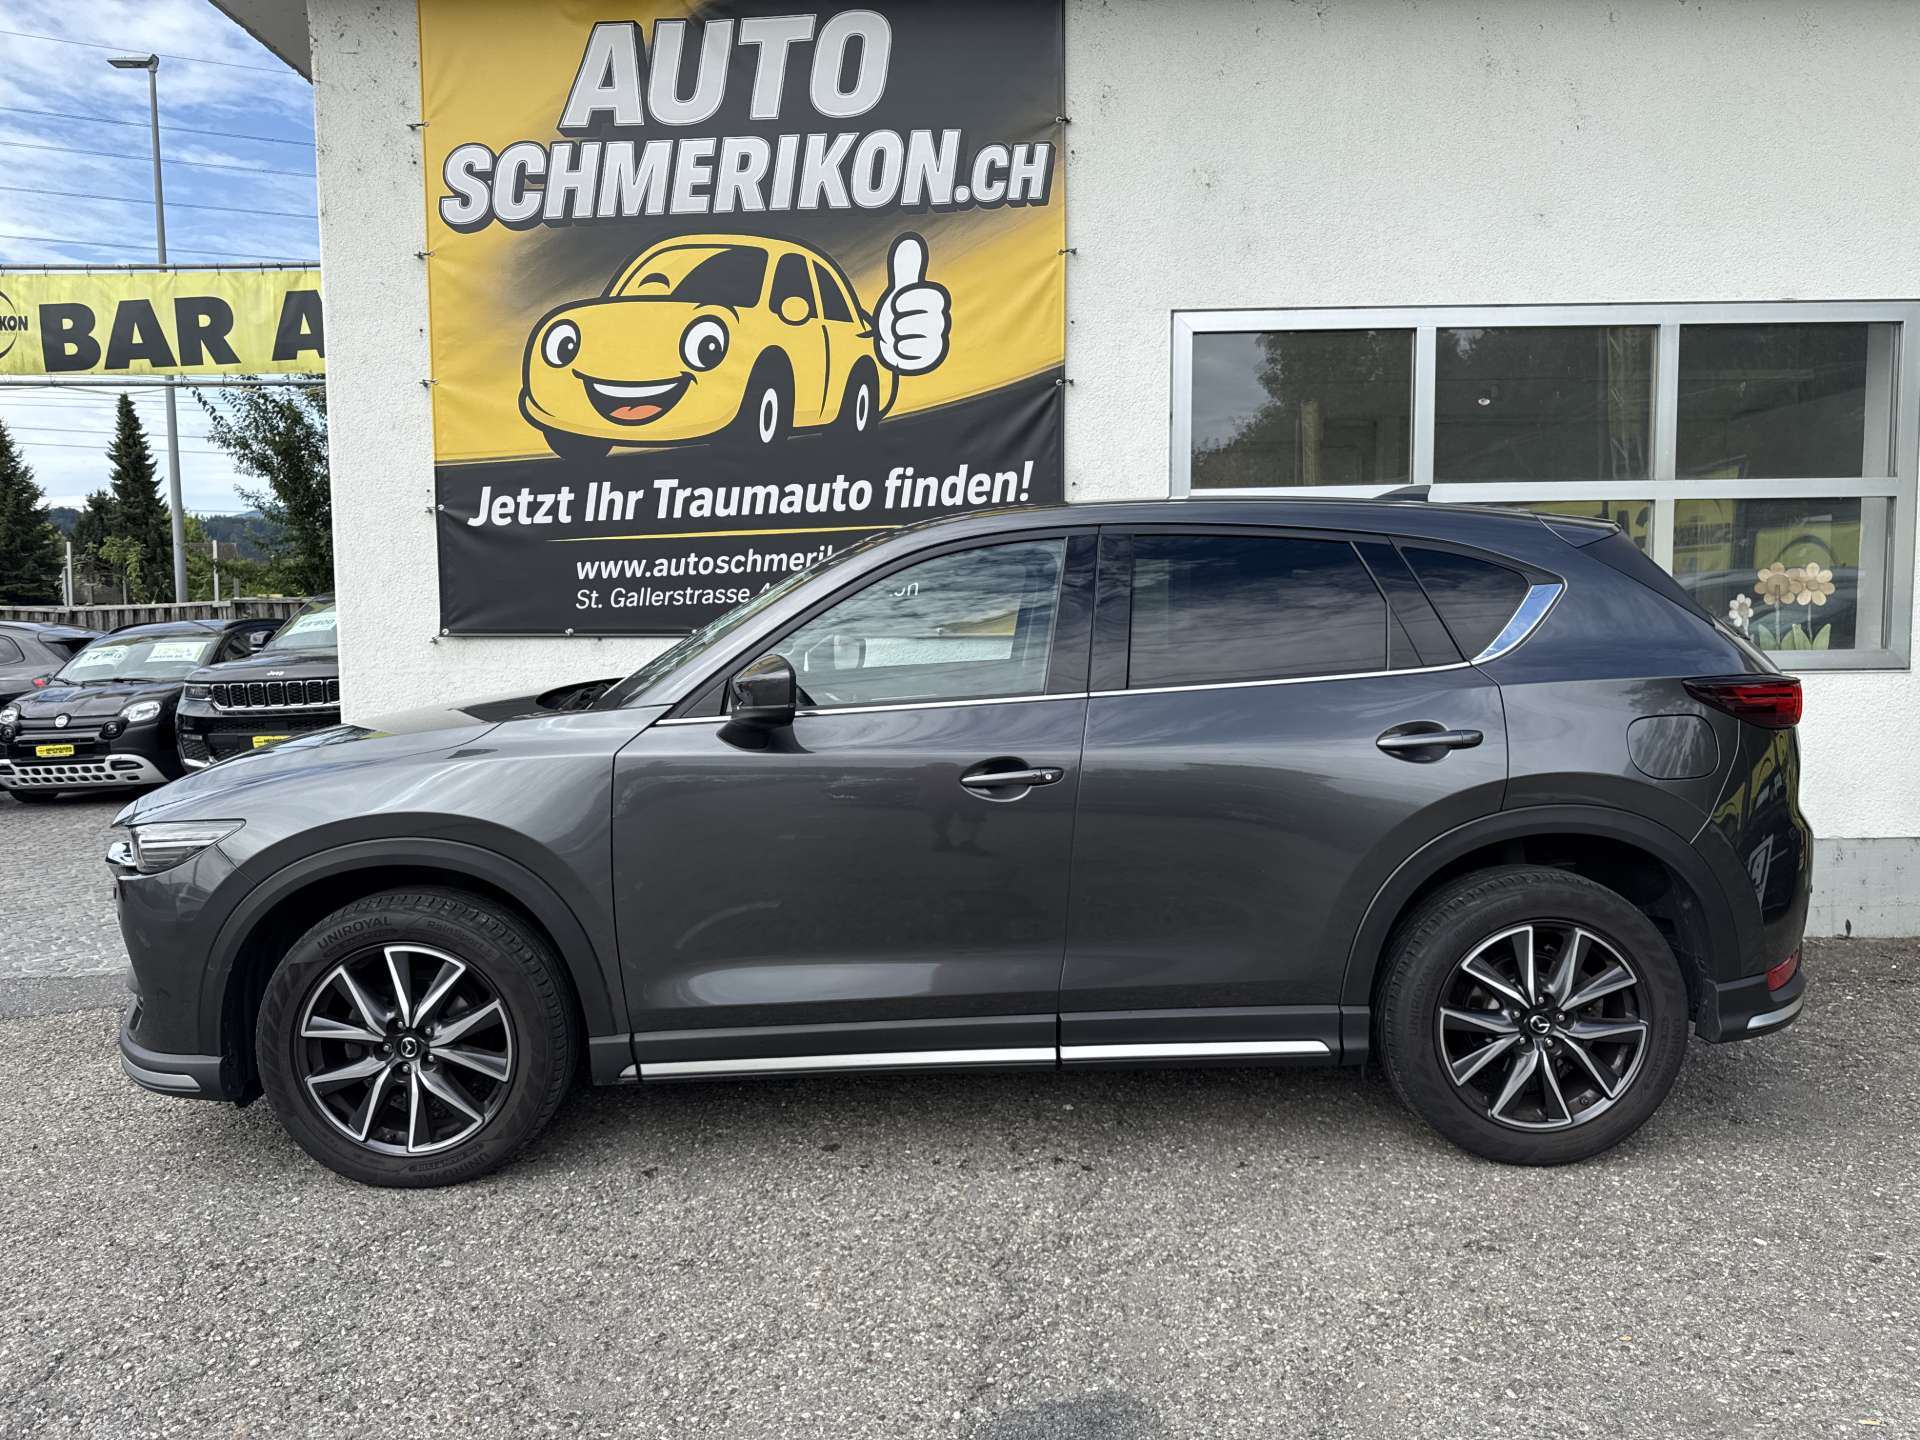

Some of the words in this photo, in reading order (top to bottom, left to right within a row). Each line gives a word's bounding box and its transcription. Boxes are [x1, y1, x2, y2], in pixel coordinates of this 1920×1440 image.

[561, 8, 893, 129] AUTO
[440, 128, 1052, 225] SCHMERIKON.CH
[38, 296, 241, 372] BAR
[272, 289, 325, 361] A
[466, 486, 575, 527] Jetzt
[584, 481, 645, 522] Ihr
[653, 474, 873, 520] Traumauto
[884, 460, 1034, 510] finden!
[575, 589, 603, 609] St.
[610, 586, 751, 608] Gallerstrasse
[317, 915, 393, 949] UNIROYAL
